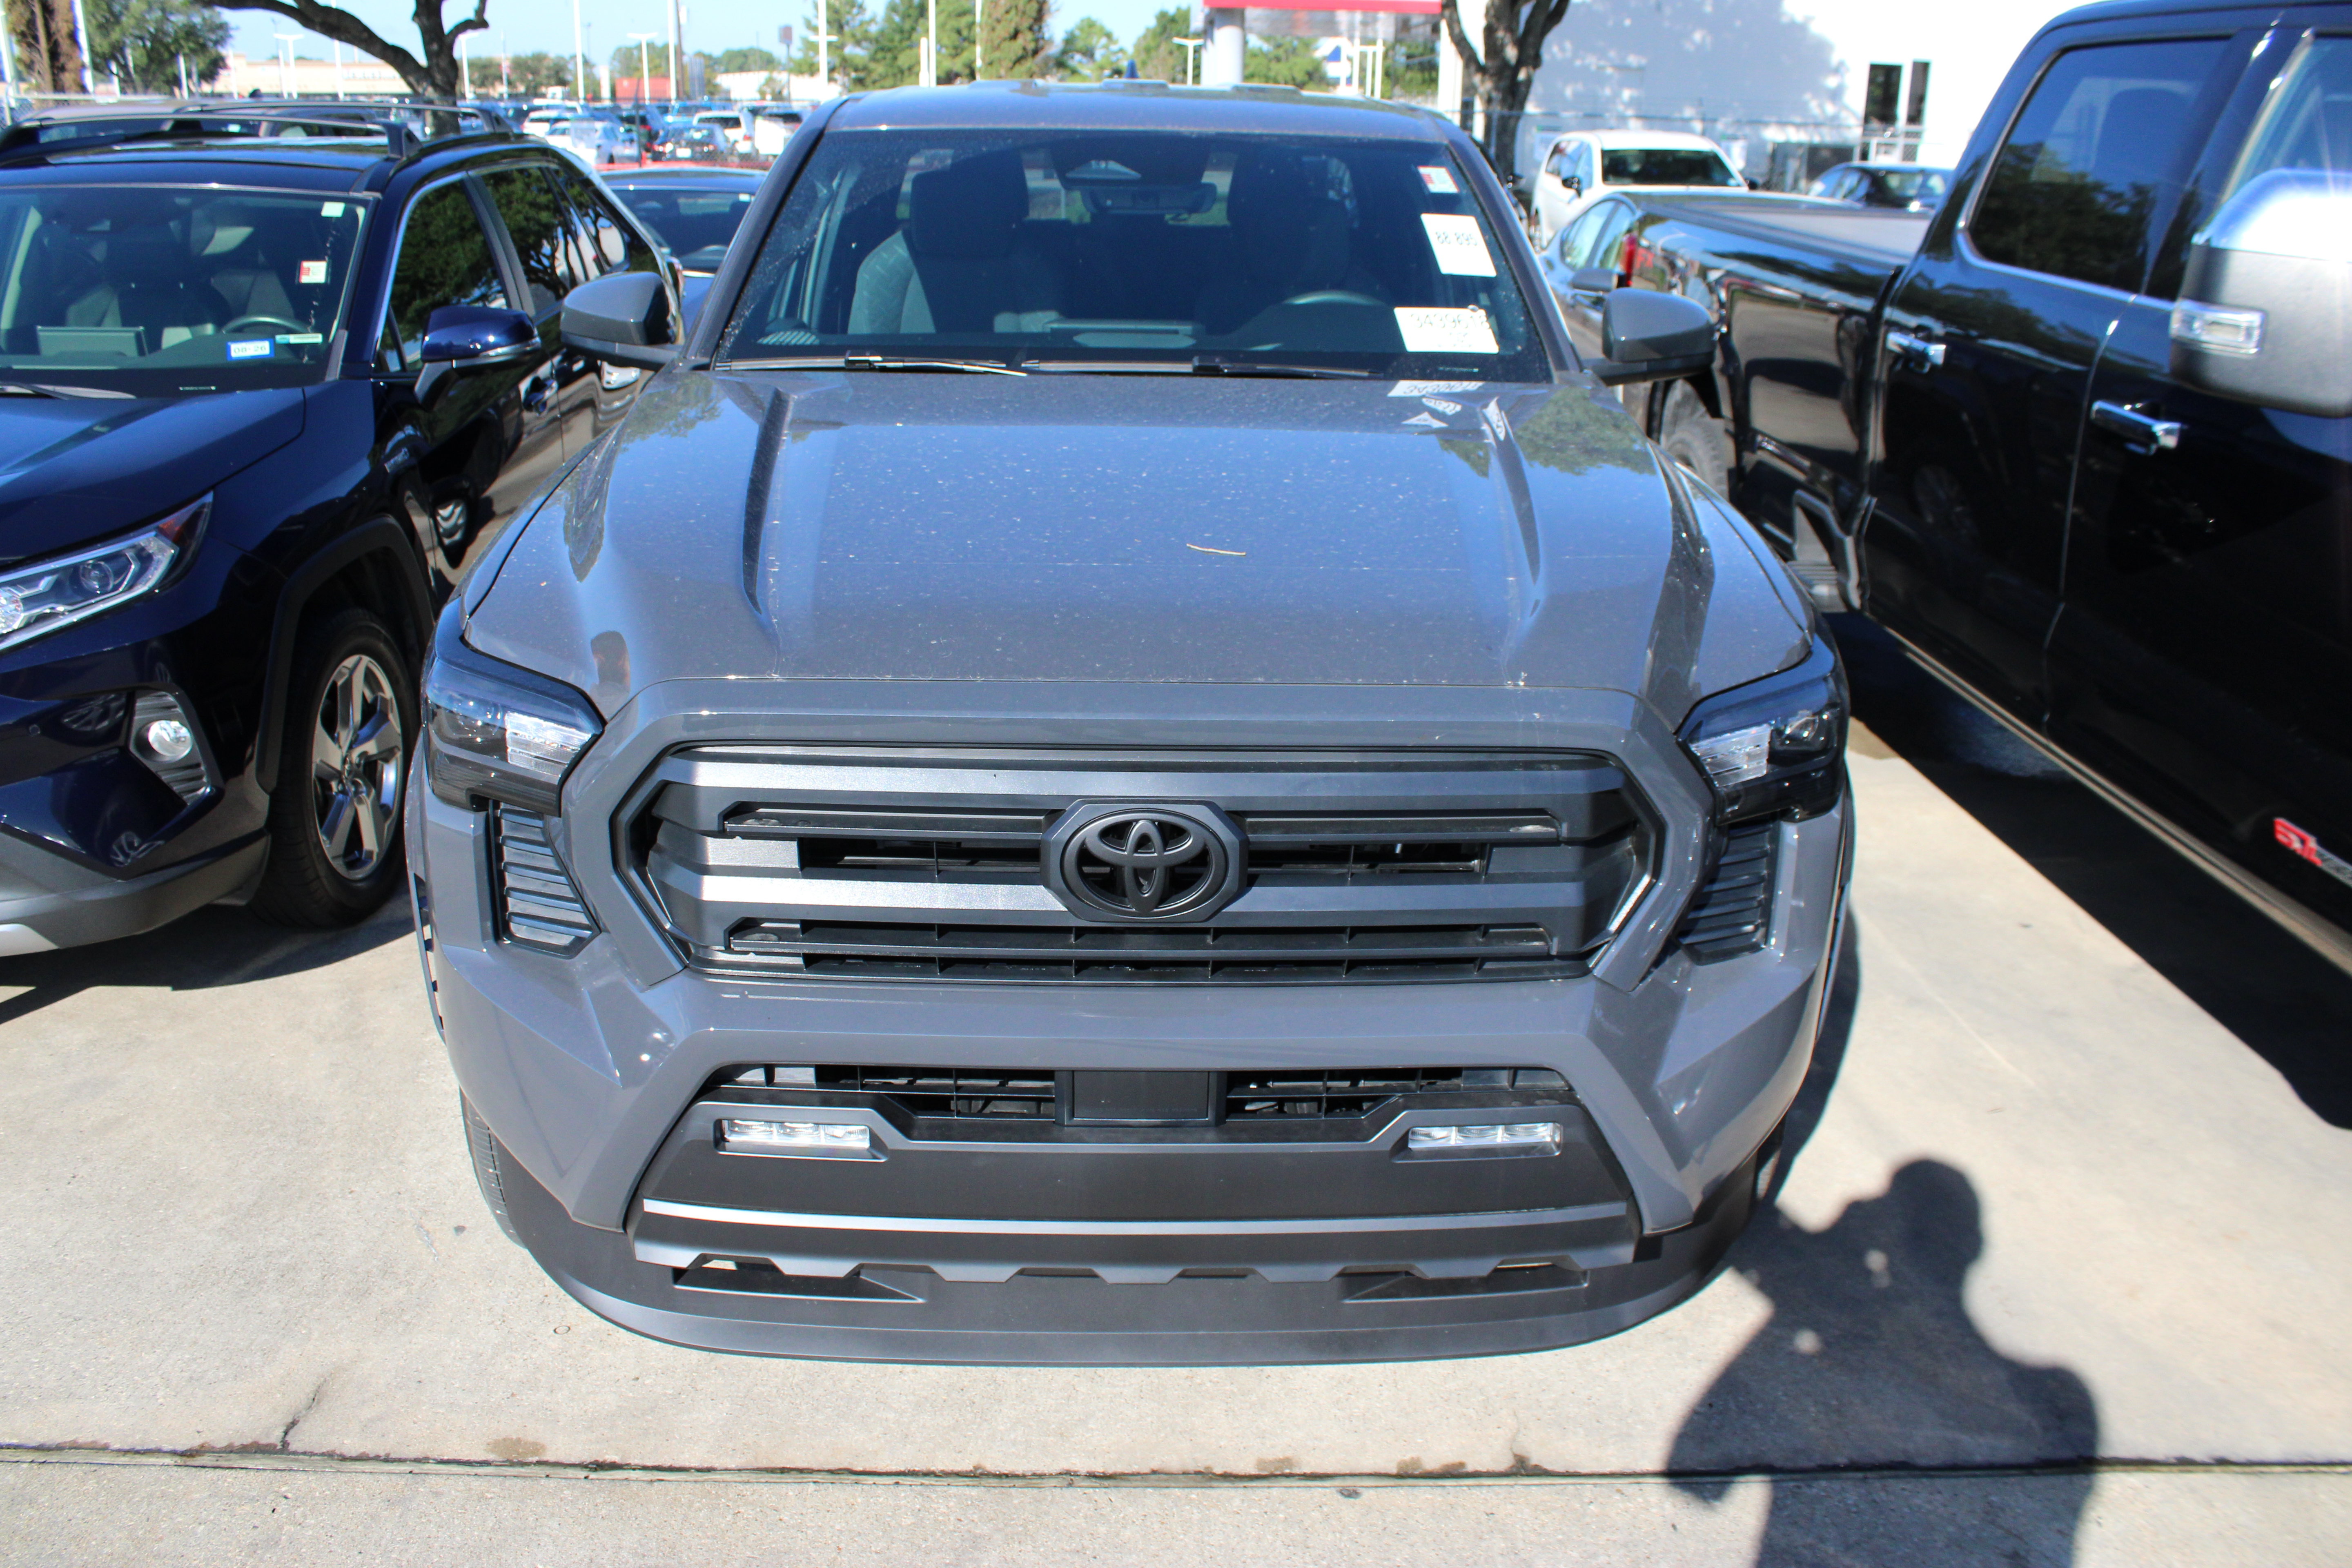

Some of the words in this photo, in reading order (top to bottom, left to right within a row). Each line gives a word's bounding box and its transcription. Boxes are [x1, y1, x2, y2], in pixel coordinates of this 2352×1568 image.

[1435, 231, 1451, 245] 88
[1454, 232, 1478, 247] 895
[1410, 313, 1490, 330] 3439618
